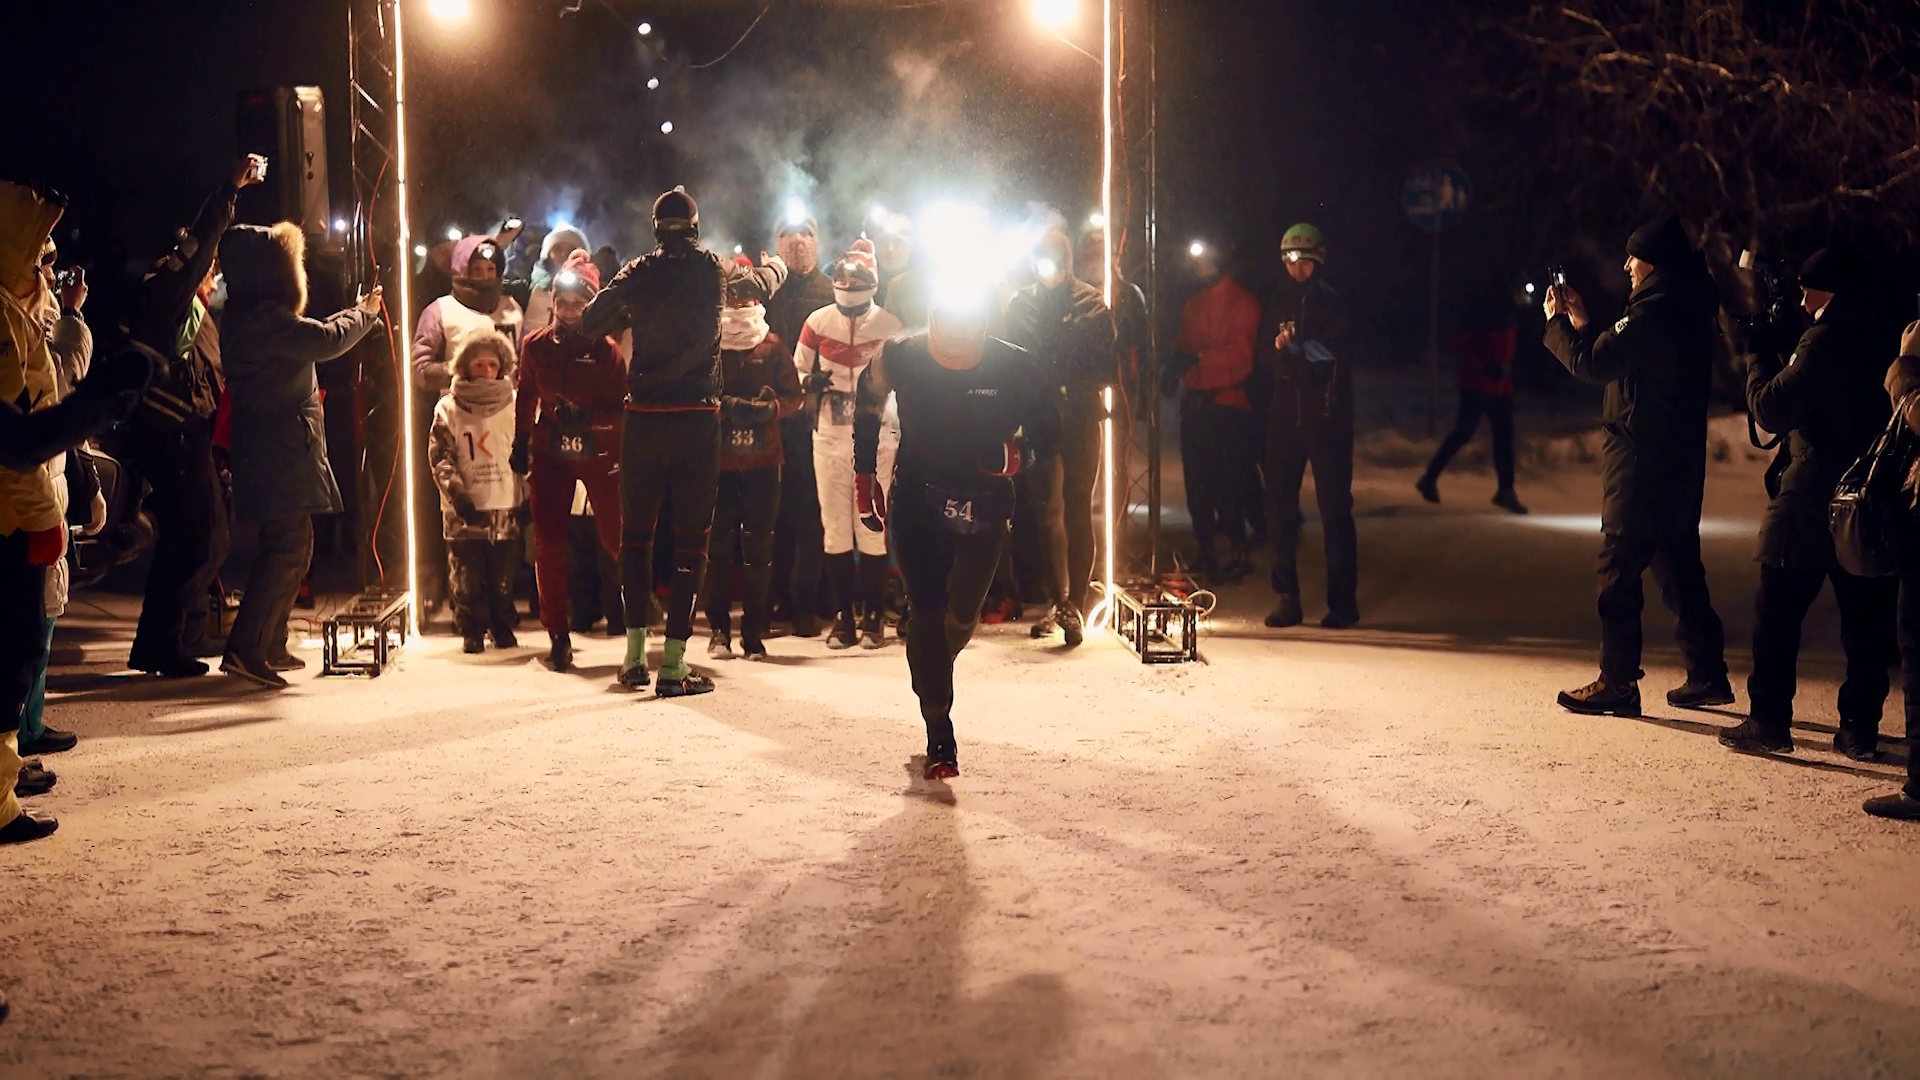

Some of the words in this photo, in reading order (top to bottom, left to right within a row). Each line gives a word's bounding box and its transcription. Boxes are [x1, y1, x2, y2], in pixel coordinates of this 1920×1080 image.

[560, 435, 583, 452] 36
[731, 429, 755, 446] 33
[943, 499, 973, 522] 54
